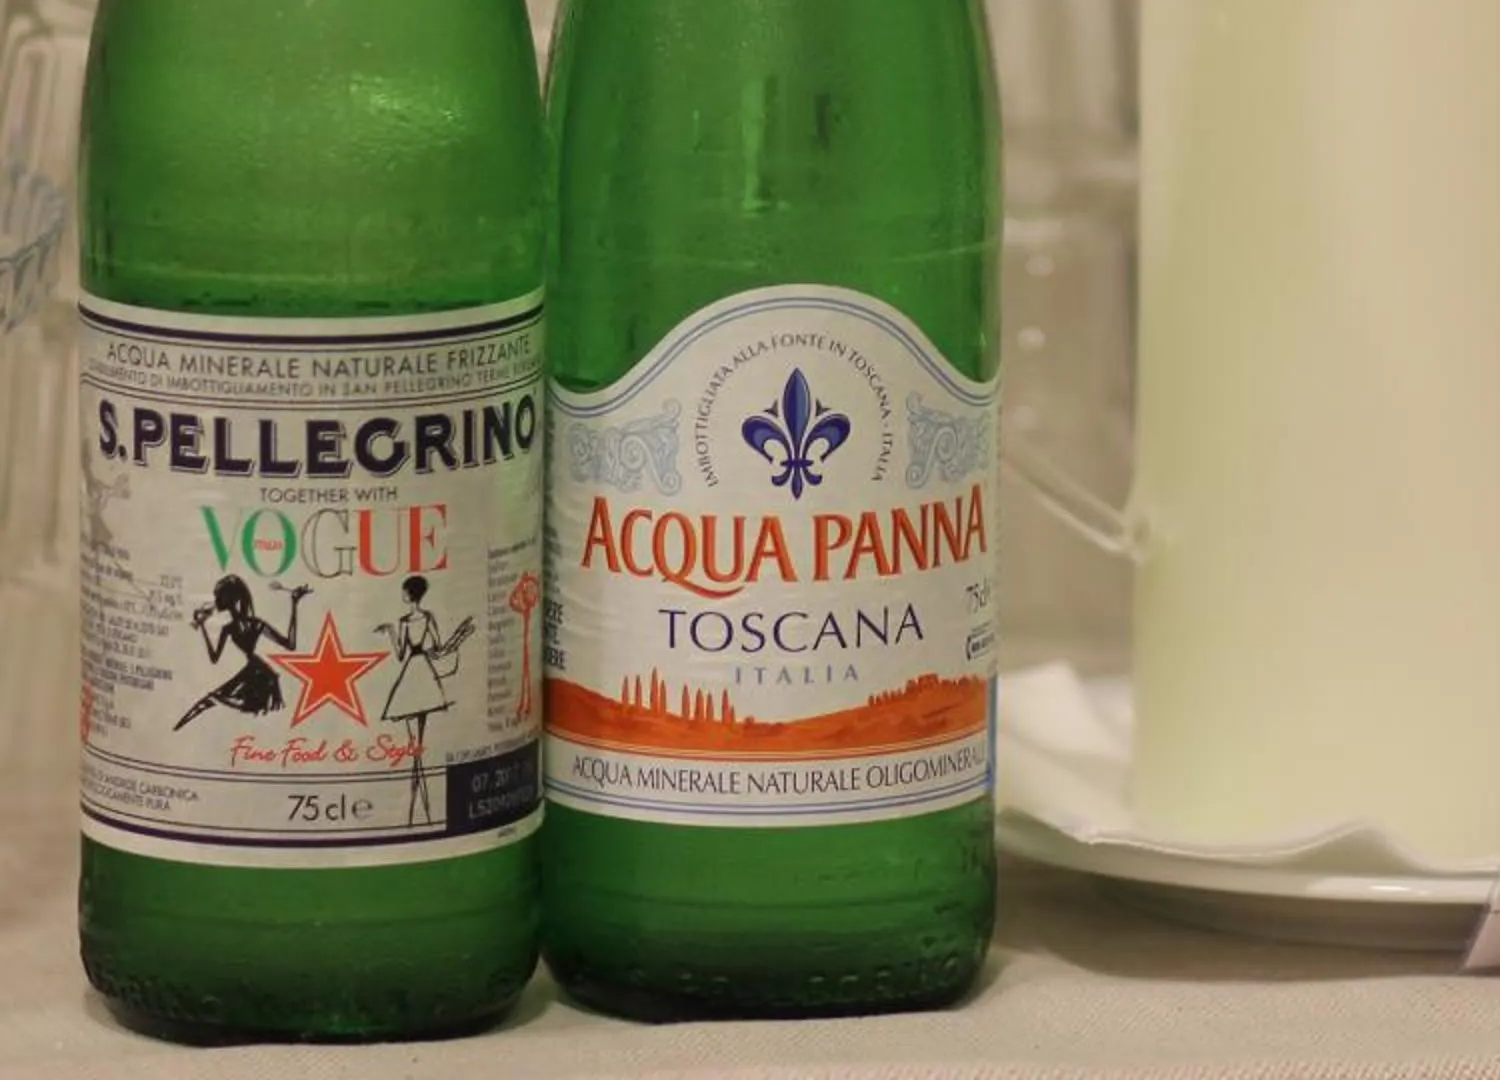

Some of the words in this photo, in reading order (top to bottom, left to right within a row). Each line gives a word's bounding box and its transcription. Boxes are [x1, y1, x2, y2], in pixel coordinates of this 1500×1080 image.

[106, 342, 170, 370] ACQUA
[180, 354, 300, 380] MINERALE
[312, 352, 437, 379] NATURALE
[447, 332, 529, 369] FRIZZANTE
[341, 381, 377, 397] SAN
[384, 372, 473, 395] PELLEGRINO
[695, 364, 734, 488] IMBOTTIGLIATA
[731, 340, 769, 370] ALLA
[770, 333, 828, 353] FONTE
[828, 339, 847, 358] IN
[847, 349, 893, 421] TOSCANA
[871, 431, 894, 483] ITALIA
[98, 393, 537, 479] S.PELLEGRINO
[259, 486, 350, 504] TOGETHER
[356, 485, 399, 503] WITH
[197, 503, 449, 580] VOGUE
[580, 496, 798, 600] ACQUA
[812, 483, 988, 581] PANNA
[658, 602, 925, 654] TOSCANA
[734, 664, 860, 685] ITALIA
[230, 734, 275, 768] Fine
[280, 736, 328, 768] Food
[572, 754, 633, 788] ACQUA
[637, 767, 741, 795] MINERALE
[747, 767, 861, 795] NATURALE
